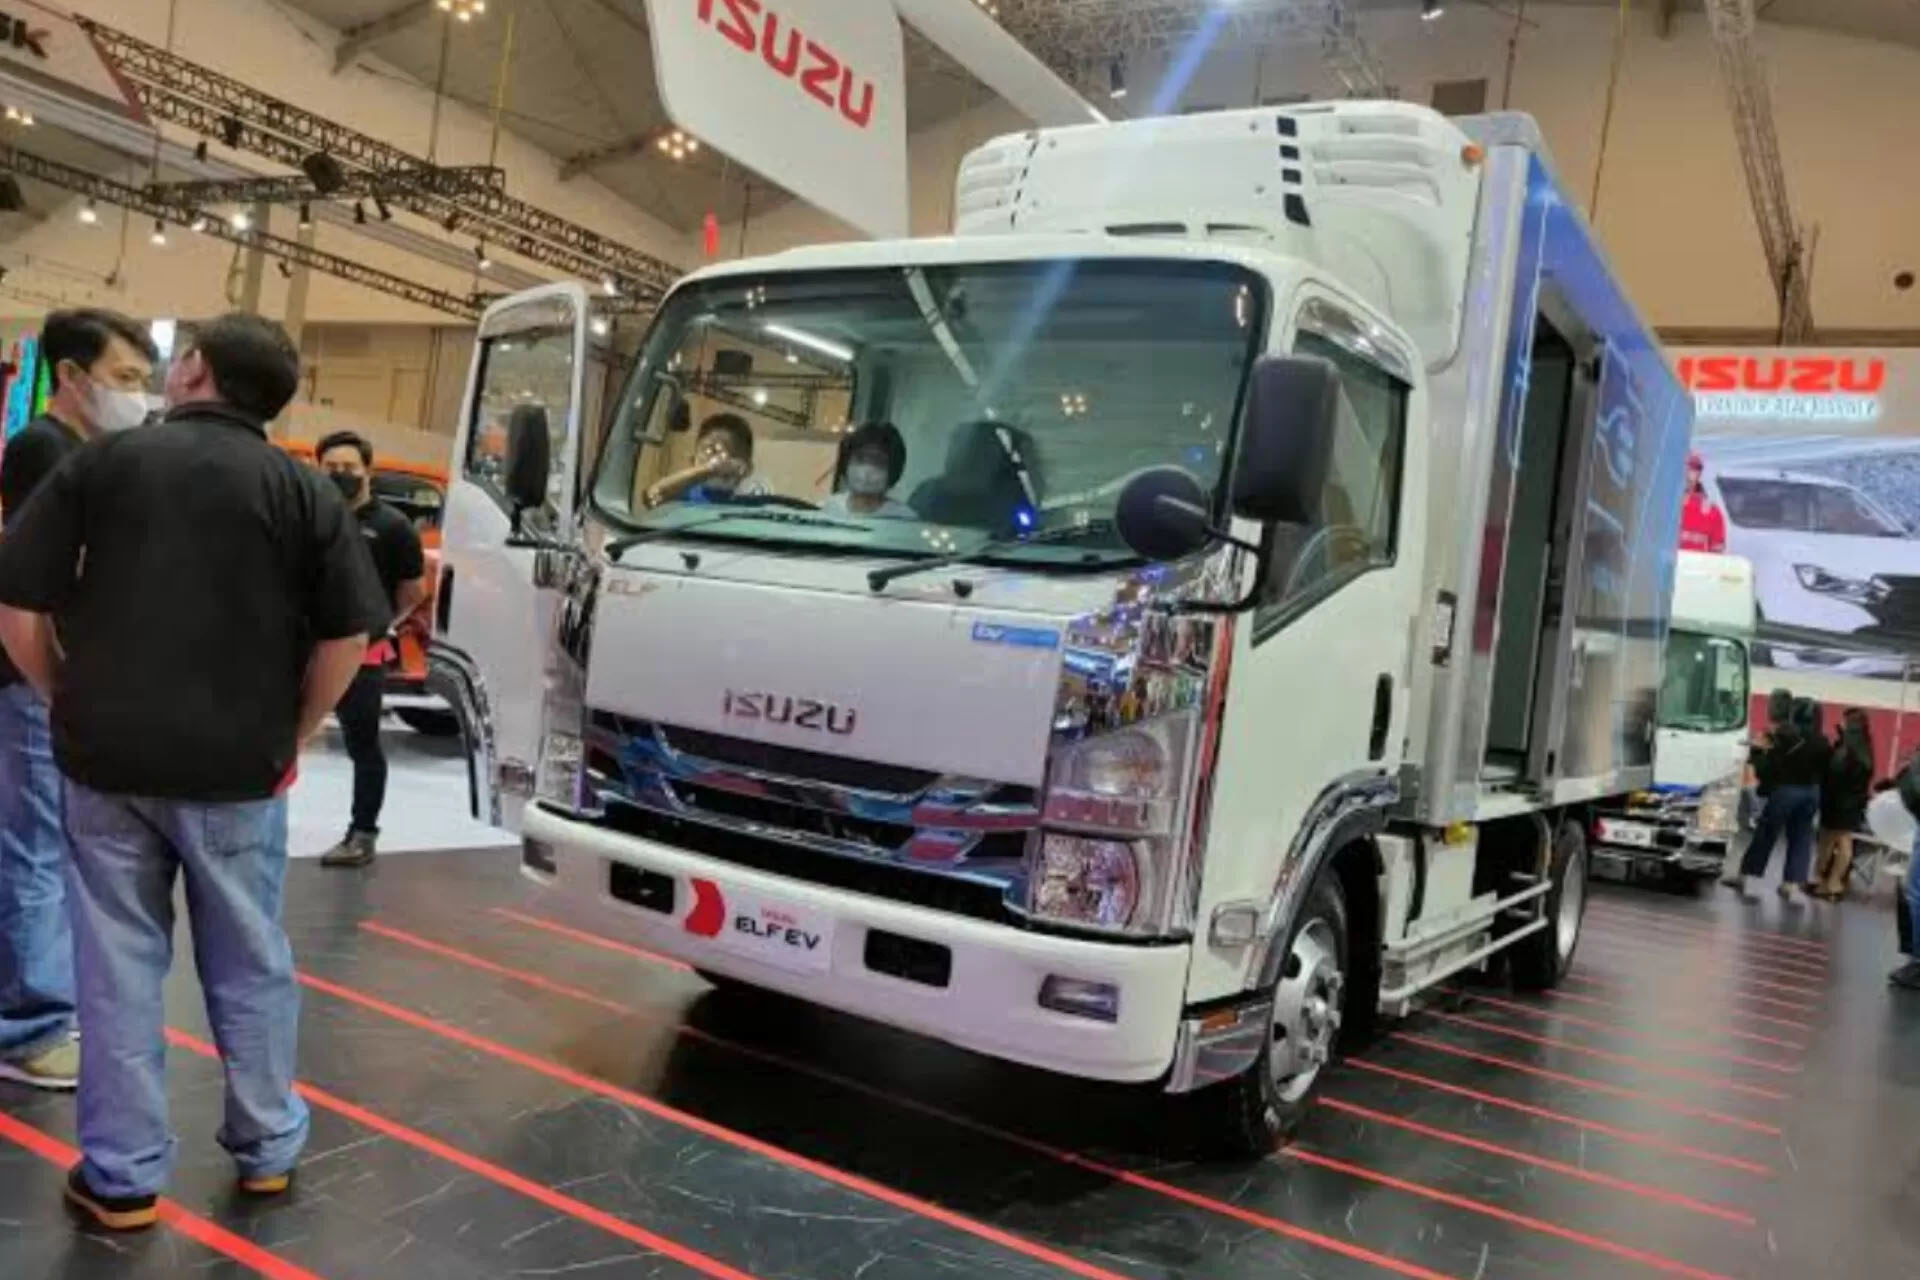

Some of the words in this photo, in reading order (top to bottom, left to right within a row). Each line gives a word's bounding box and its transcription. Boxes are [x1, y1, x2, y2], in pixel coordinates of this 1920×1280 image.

[1677, 357, 1885, 391] ISUZU
[724, 688, 857, 735] ISUZU
[735, 916, 783, 938] ELF
[784, 929, 820, 950] EV
